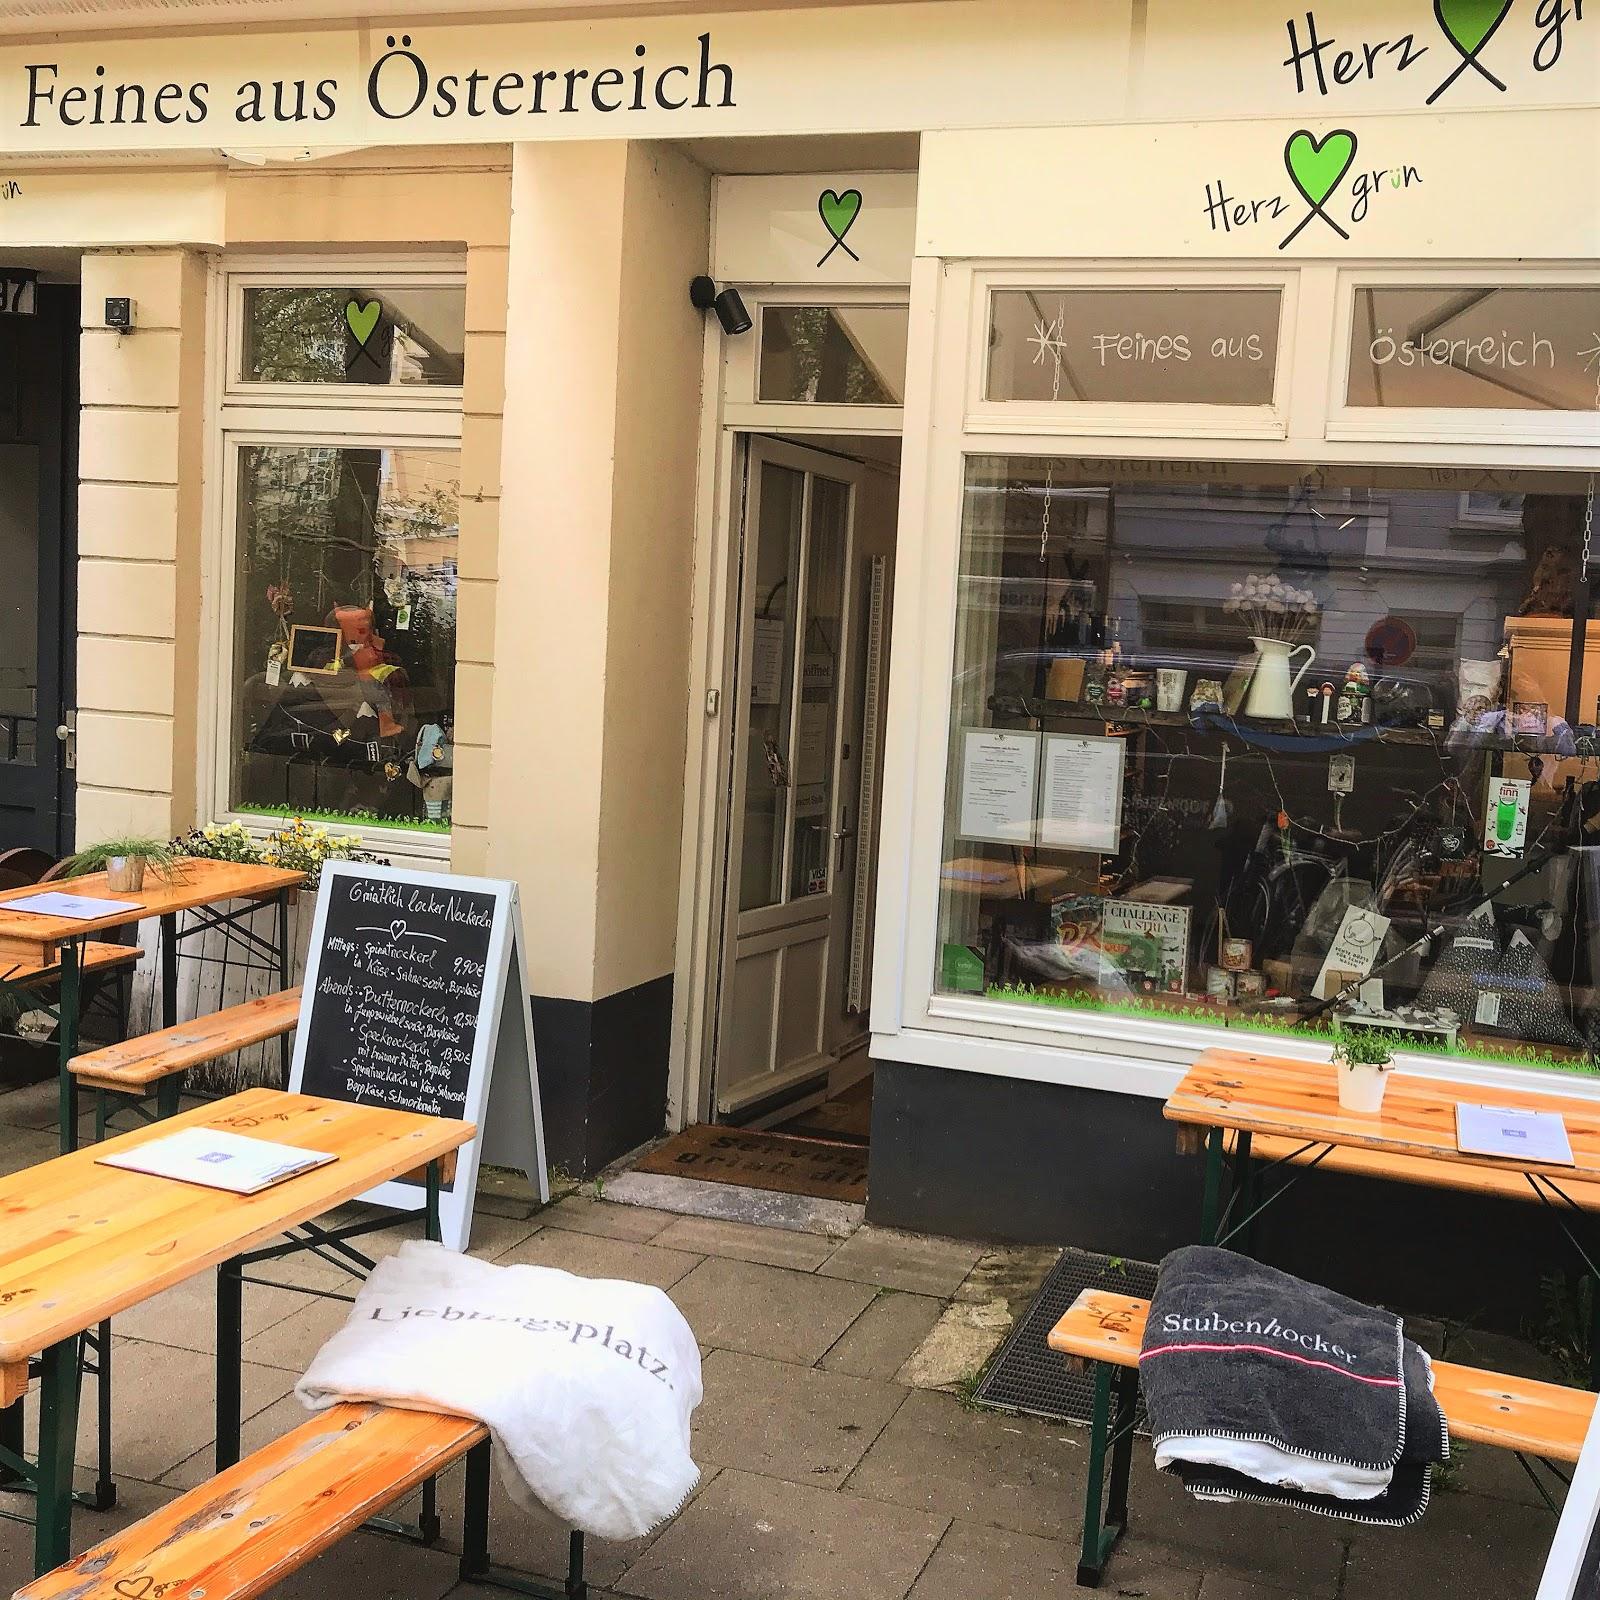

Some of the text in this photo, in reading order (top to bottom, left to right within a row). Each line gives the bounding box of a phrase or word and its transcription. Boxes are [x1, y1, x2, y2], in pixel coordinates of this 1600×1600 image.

[1283, 11, 1429, 95] Herz
[20, 32, 737, 126] Feines aus Österreich
[1203, 166, 1423, 232] Herz grün
[1092, 332, 1263, 366] Feines aus
[1369, 328, 1554, 369] Österreich
[408, 889, 445, 914] locker
[444, 895, 492, 929] Nockerln
[1110, 907, 1180, 924] CHALLENGE
[1122, 919, 1169, 934] AUSTRIA
[327, 936, 359, 957] Mittags:
[453, 956, 484, 977] 9,90€
[353, 953, 362, 968] in
[344, 997, 352, 1014] in
[364, 985, 450, 1026] Butternockerln
[440, 1047, 472, 1065] 13,50€
[410, 1074, 418, 1089] in
[1161, 1311, 1357, 1366] Stubenhocker
